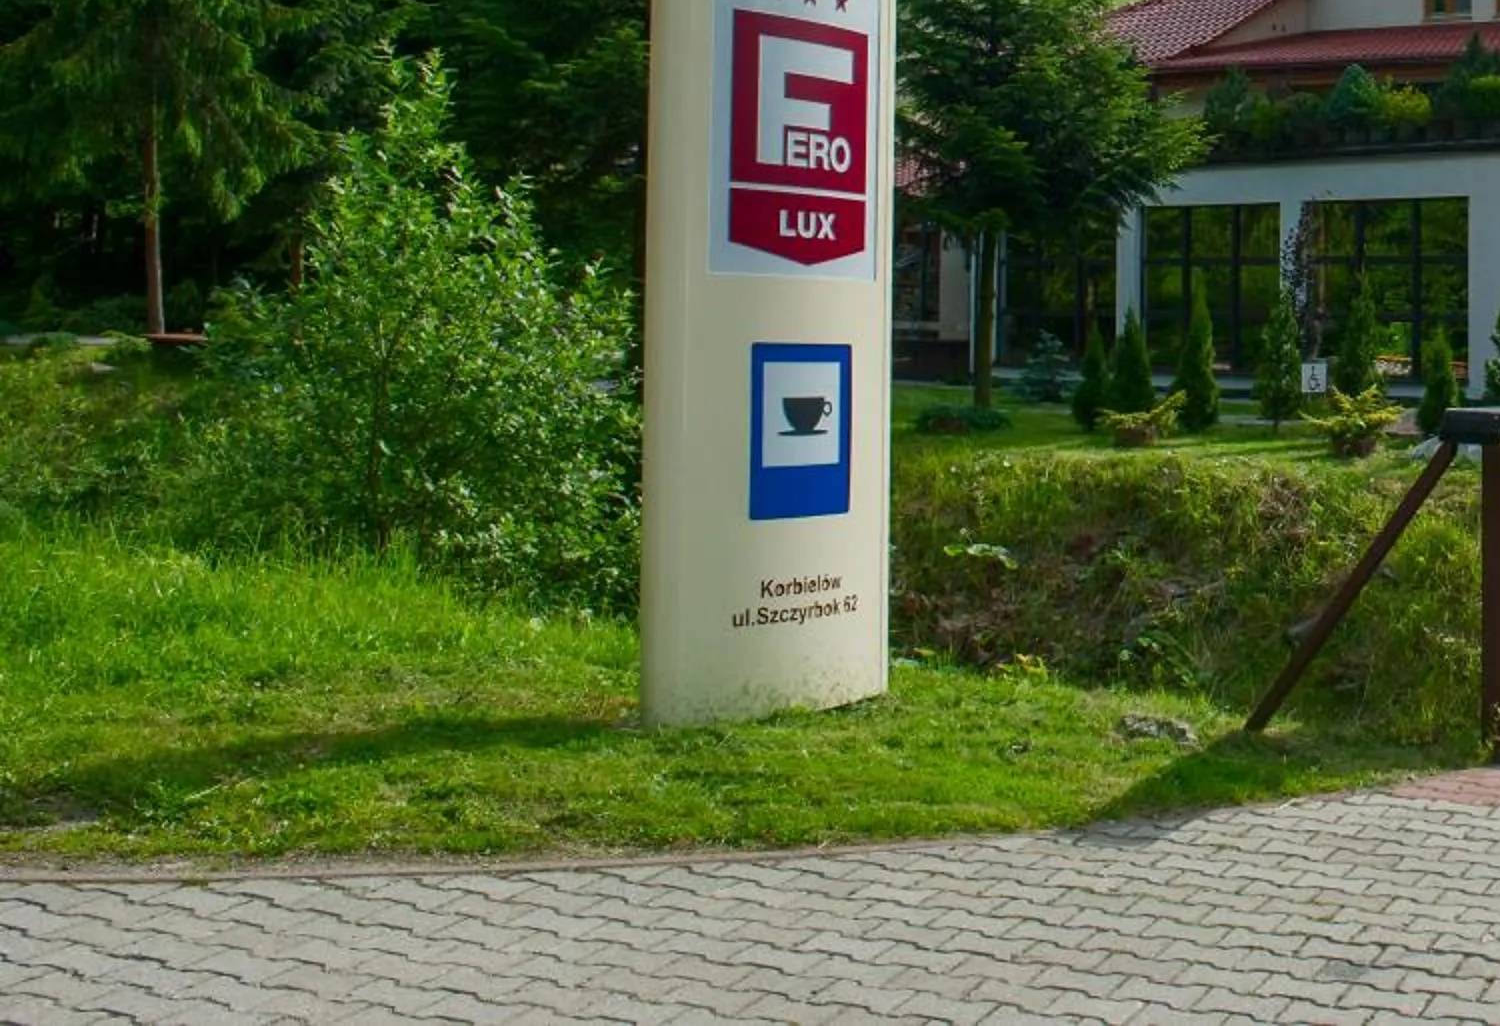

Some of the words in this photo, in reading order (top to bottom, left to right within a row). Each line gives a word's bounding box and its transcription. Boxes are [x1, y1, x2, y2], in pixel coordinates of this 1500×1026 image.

[756, 33, 855, 174] FERO
[779, 208, 836, 241] LUX
[760, 574, 842, 598] Korbielów
[843, 594, 858, 612] 62
